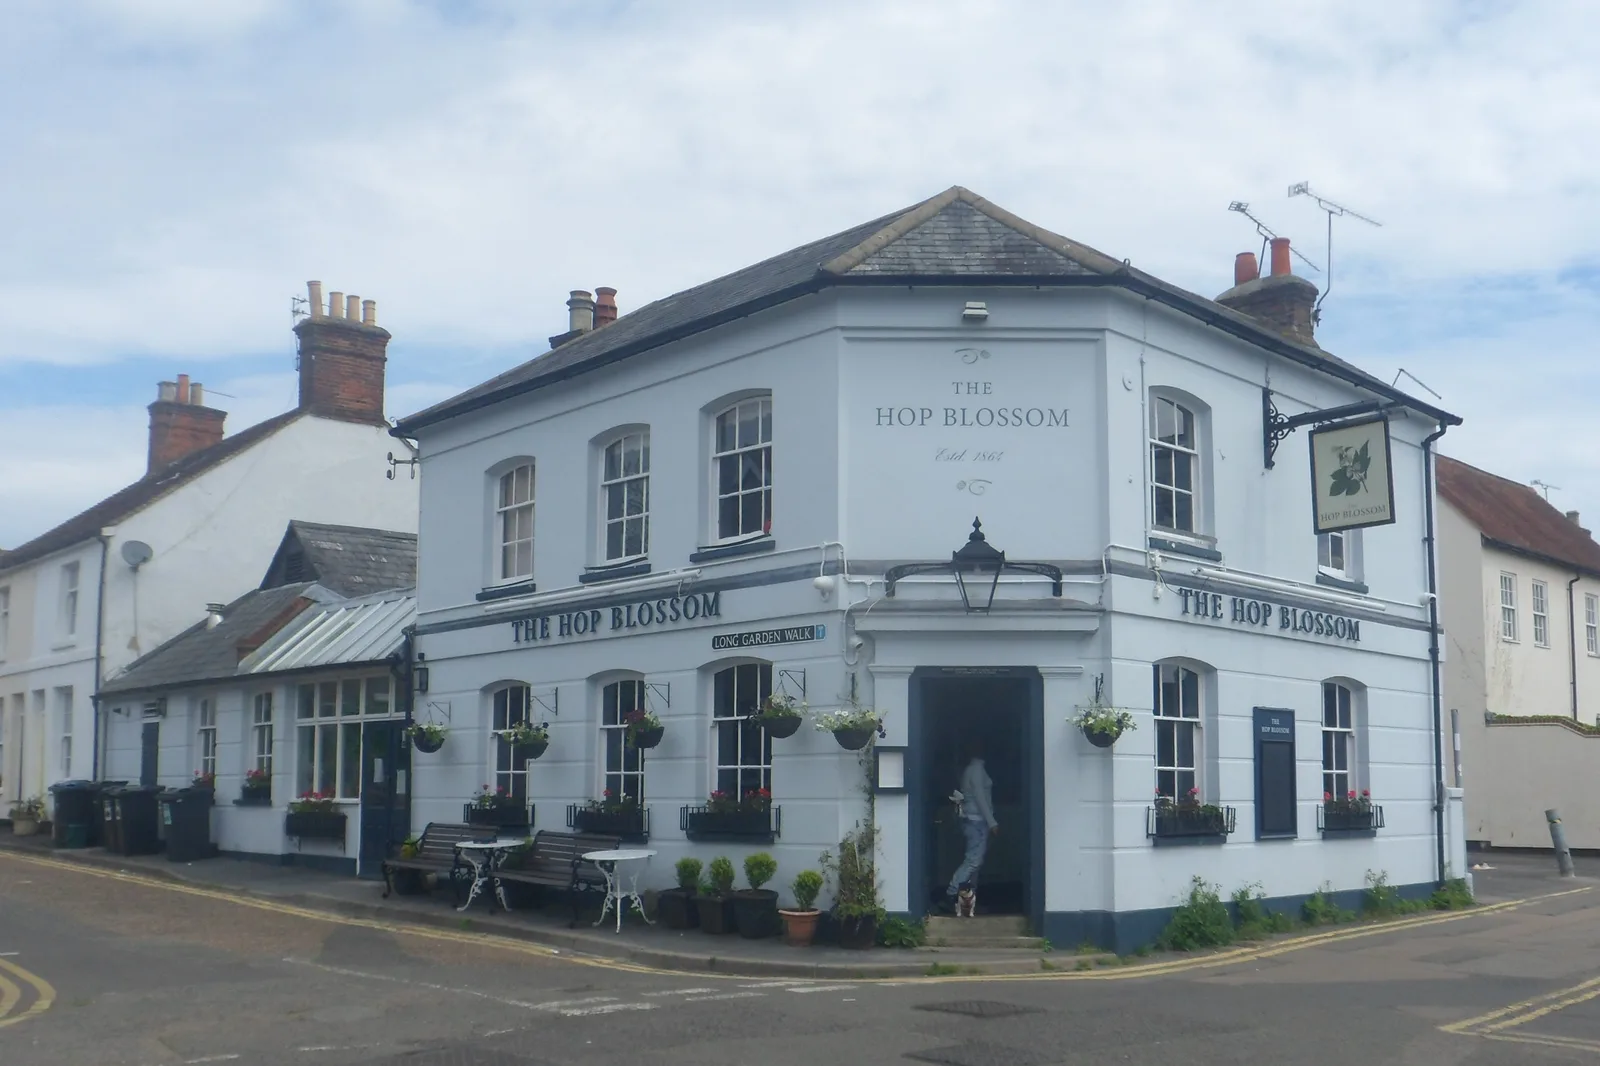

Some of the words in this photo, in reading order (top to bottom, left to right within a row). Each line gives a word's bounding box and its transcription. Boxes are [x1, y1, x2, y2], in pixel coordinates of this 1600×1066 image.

[952, 381, 993, 395] THE
[875, 407, 933, 427] HOP
[943, 407, 1070, 428] BLOSSOM
[1342, 504, 1387, 519] BLOSSOM
[511, 616, 551, 643] THE
[557, 609, 602, 638] HOP
[609, 591, 722, 631] BLOSSOM
[1179, 587, 1224, 620] THE
[1231, 596, 1273, 627] HOP
[1279, 606, 1361, 642] BLOSSOM
[714, 633, 739, 649] LONG
[742, 630, 781, 646] GARDEN
[784, 627, 812, 641] WALK
